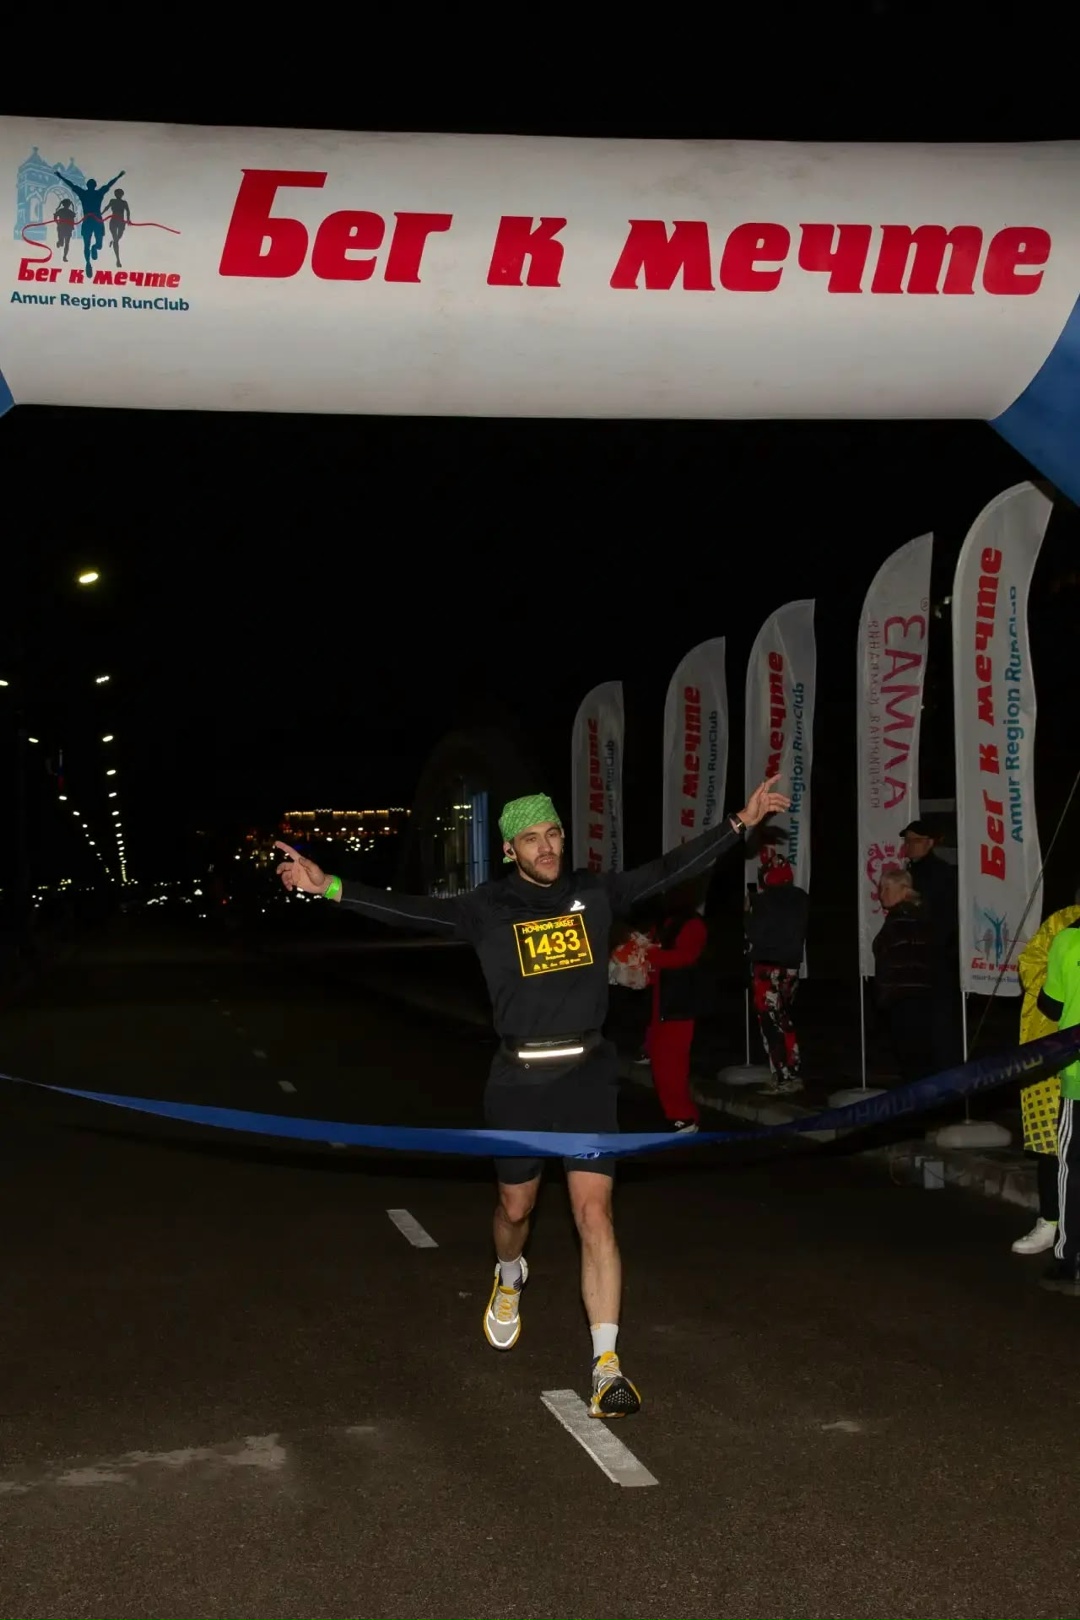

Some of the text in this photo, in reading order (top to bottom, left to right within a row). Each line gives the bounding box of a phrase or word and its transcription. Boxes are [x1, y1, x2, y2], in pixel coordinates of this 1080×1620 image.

[18, 258, 181, 288] Бег к мечте
[218, 168, 1052, 296] Бег к мечте
[10, 291, 191, 311] Amur Region RunClub
[680, 686, 701, 828] к мечте
[703, 711, 717, 825] Region RunClub
[766, 653, 785, 777] мечте
[975, 547, 1006, 881] Бег к мечте
[1003, 687, 1025, 771] Region
[787, 682, 806, 867] Amur Region RunClub
[1005, 776, 1024, 844] Amur
[525, 929, 581, 958] 1433
